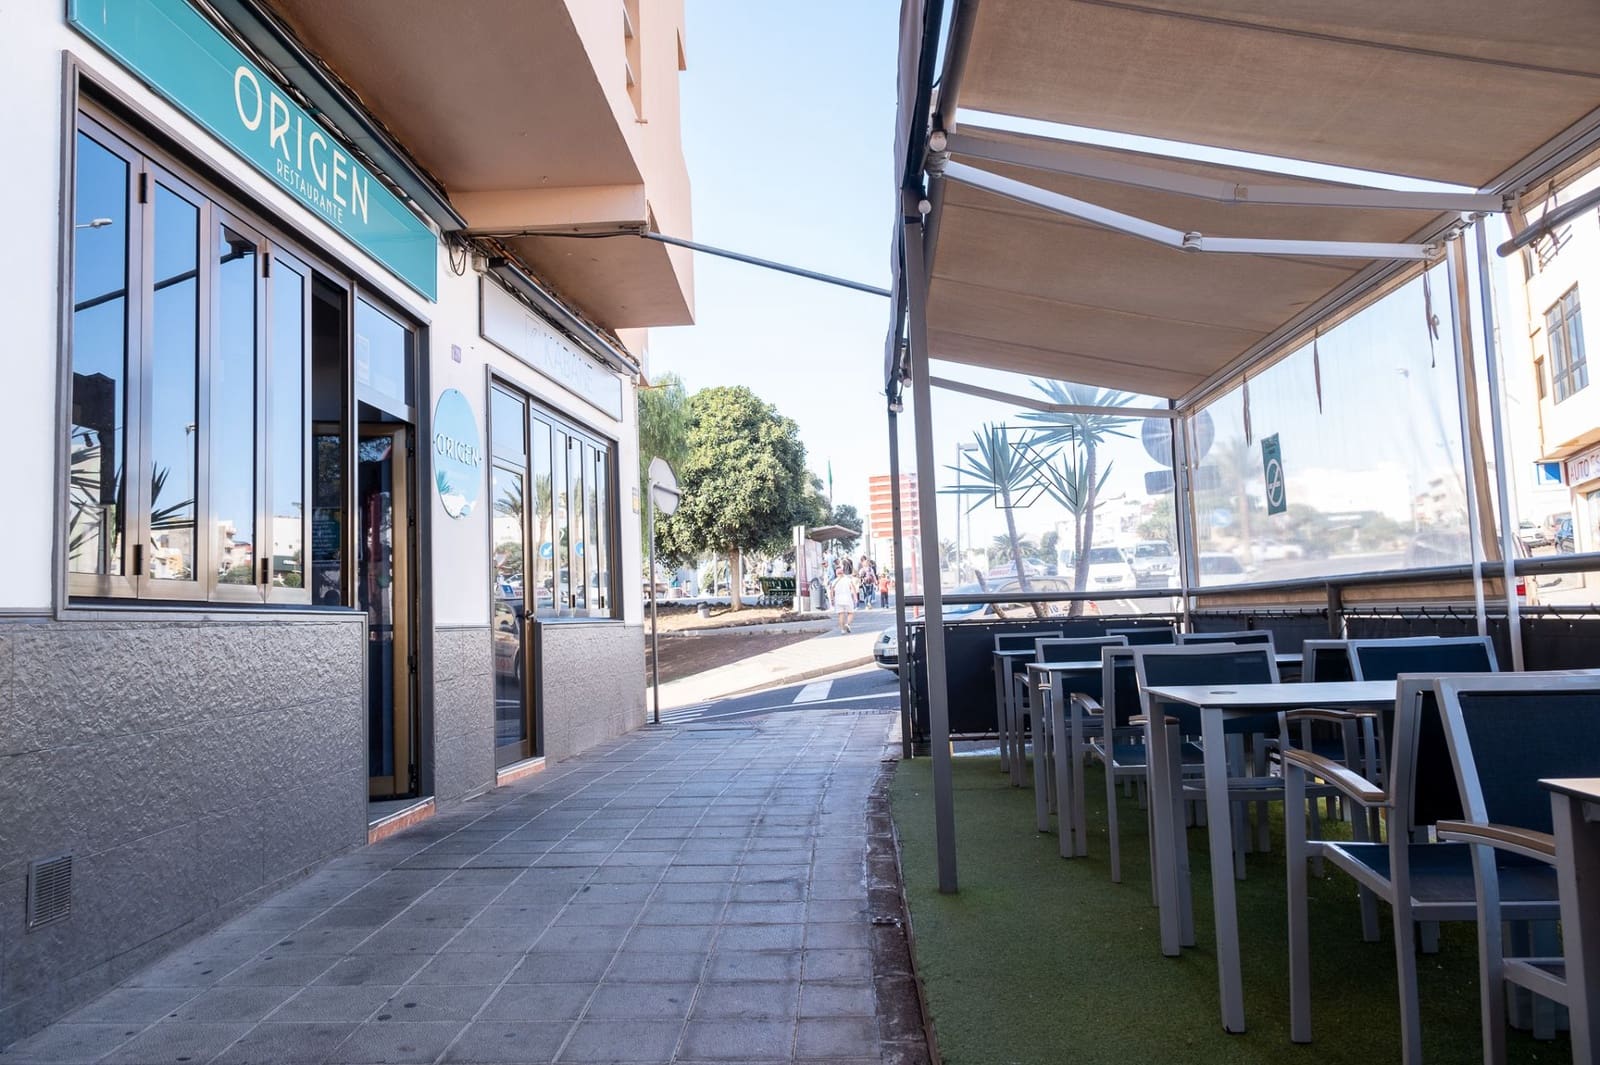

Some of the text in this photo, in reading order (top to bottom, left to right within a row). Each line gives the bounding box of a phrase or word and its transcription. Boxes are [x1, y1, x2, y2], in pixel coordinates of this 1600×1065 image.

[234, 66, 368, 224] ORIGEN
[276, 158, 344, 224] RESTAURANTE
[436, 433, 478, 468] ORIGEN
[1570, 459, 1590, 481] AUTO
